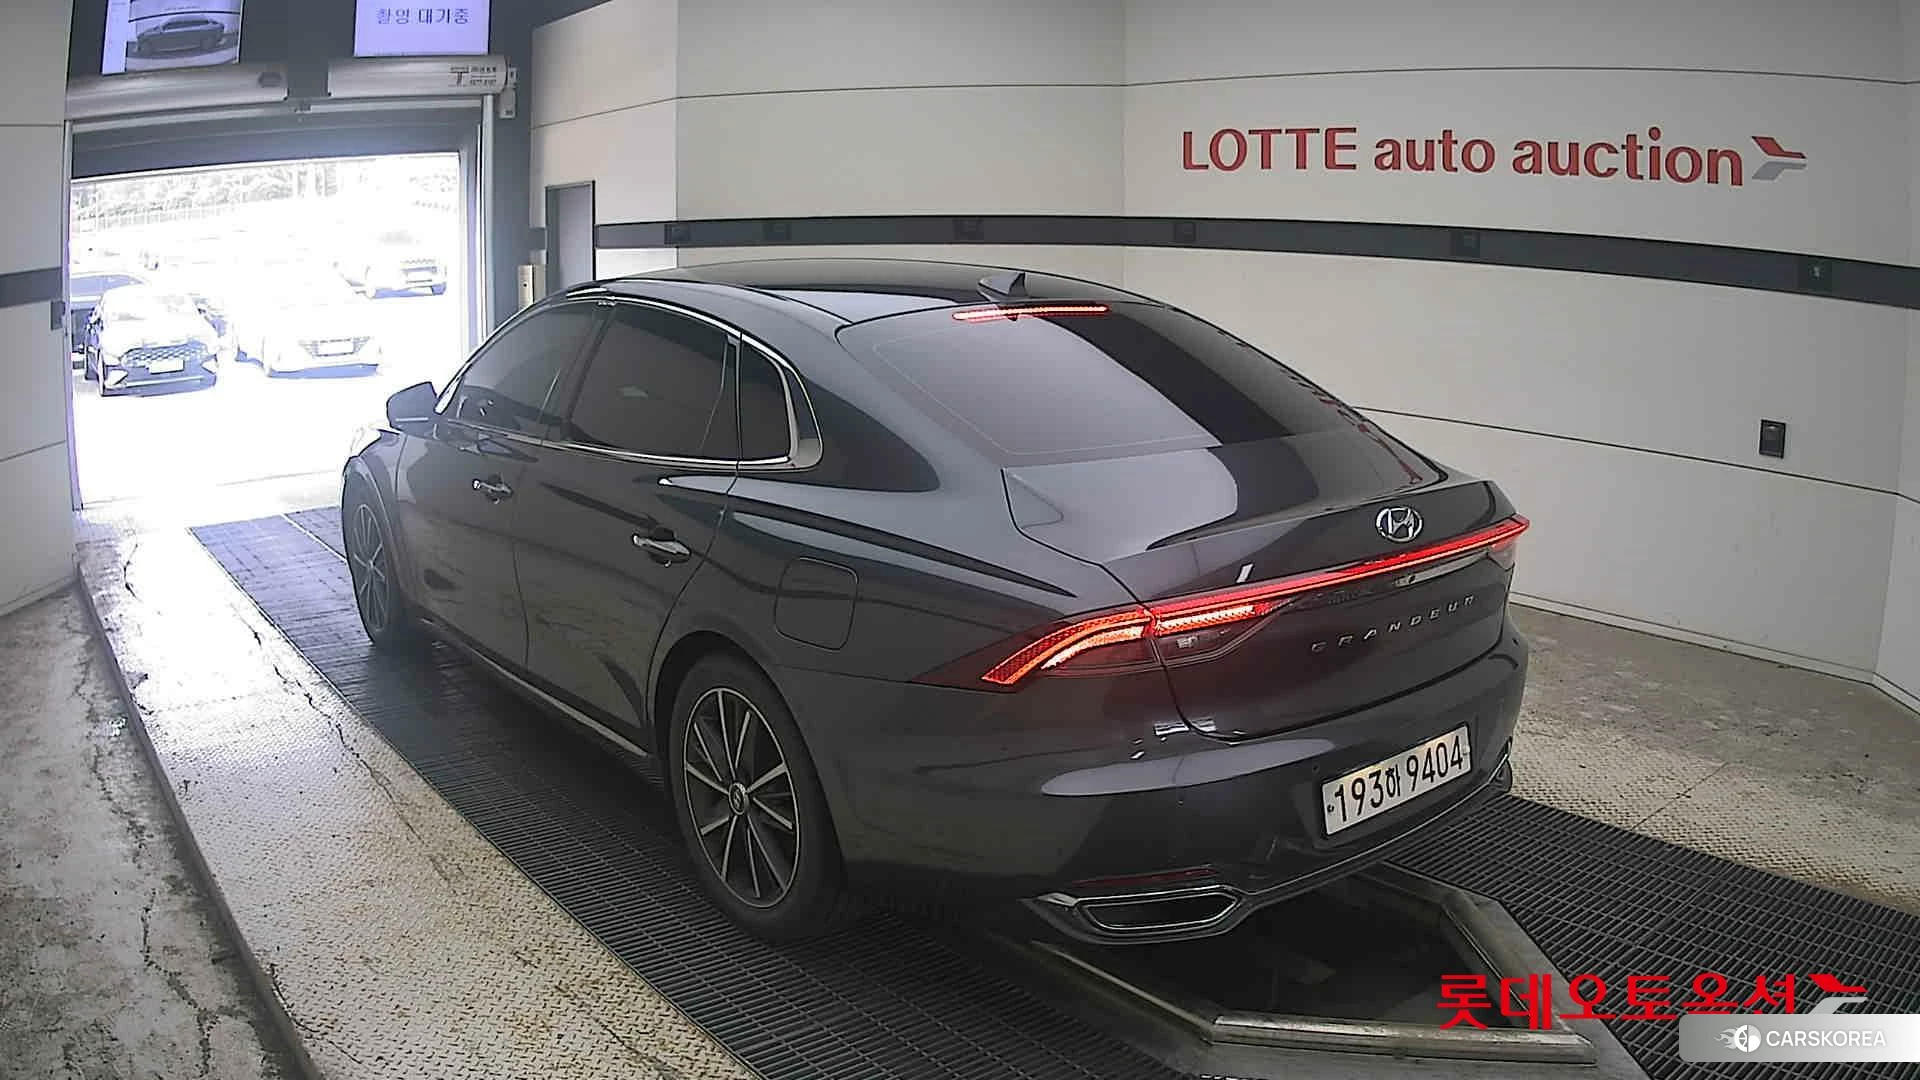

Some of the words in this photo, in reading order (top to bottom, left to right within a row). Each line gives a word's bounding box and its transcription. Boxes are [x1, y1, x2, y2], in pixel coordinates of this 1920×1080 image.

[417, 8, 469, 25] 대기중
[1183, 127, 1357, 171] LOTTE
[1374, 129, 1496, 174] auto
[1512, 126, 1743, 186] auction
[1311, 594, 1475, 652] GRANDEUR
[1334, 763, 1401, 822] 193하
[1406, 735, 1463, 792] 9404
